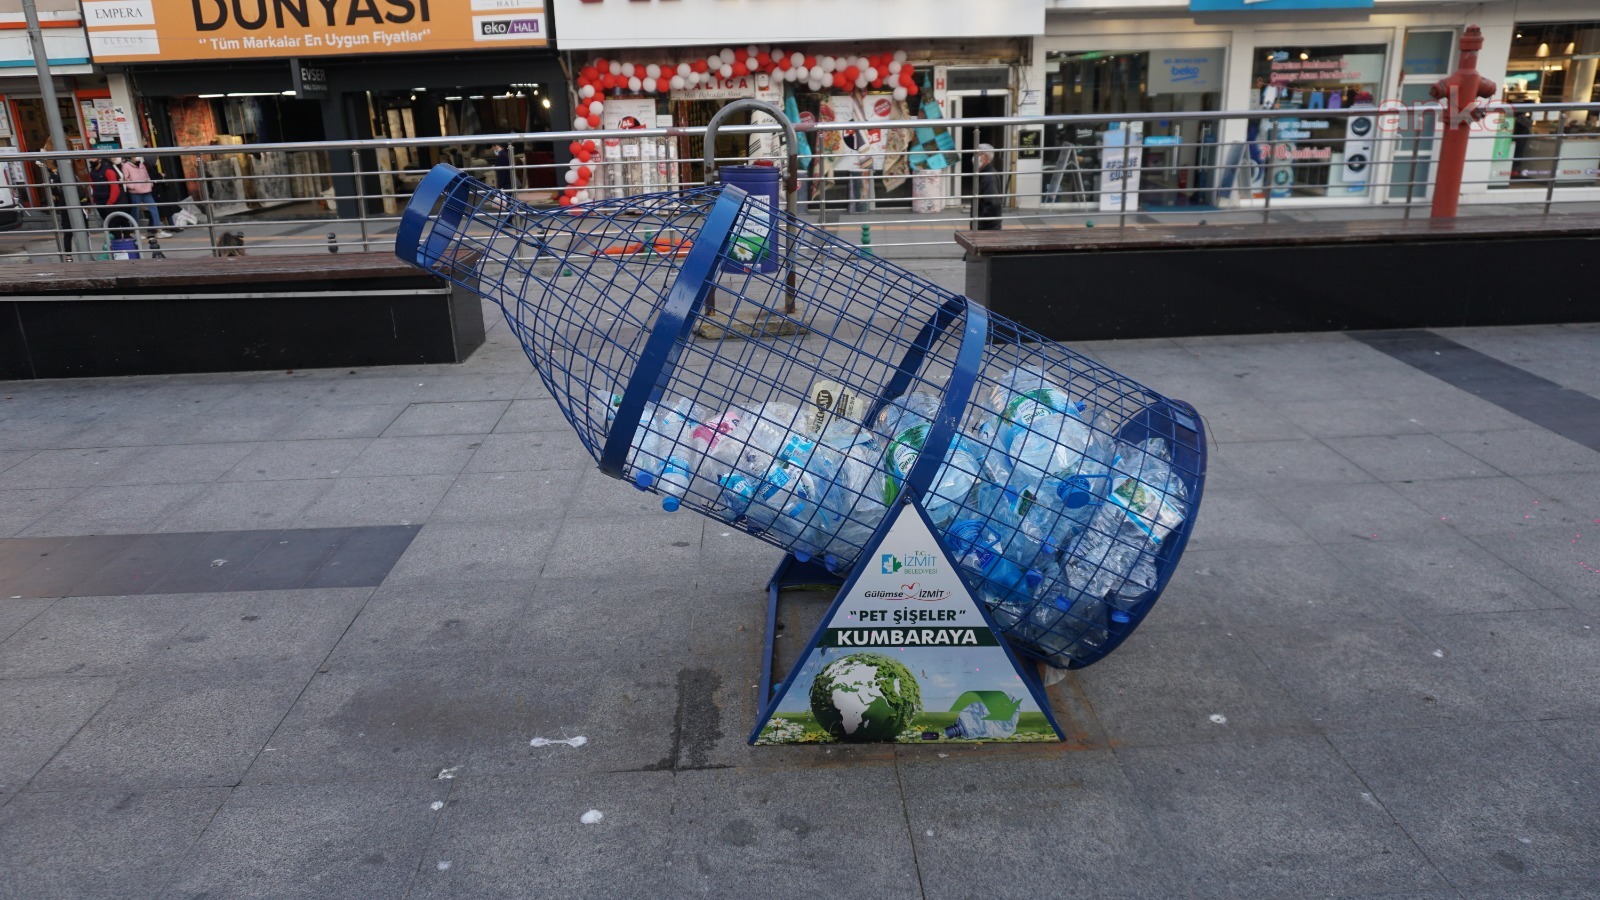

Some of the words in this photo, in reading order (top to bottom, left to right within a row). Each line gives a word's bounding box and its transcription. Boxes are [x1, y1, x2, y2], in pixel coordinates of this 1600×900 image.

[95, 8, 143, 19] EMPERA
[484, 22, 507, 33] eko
[513, 22, 537, 32] HALI
[242, 35, 301, 49] Markalar
[304, 34, 322, 47] En
[325, 33, 370, 48] Uygun
[904, 553, 938, 567] İZMİT
[864, 590, 904, 598] Gülümse
[919, 589, 945, 598] İZMİT
[837, 629, 978, 646] KUMBARAYA
